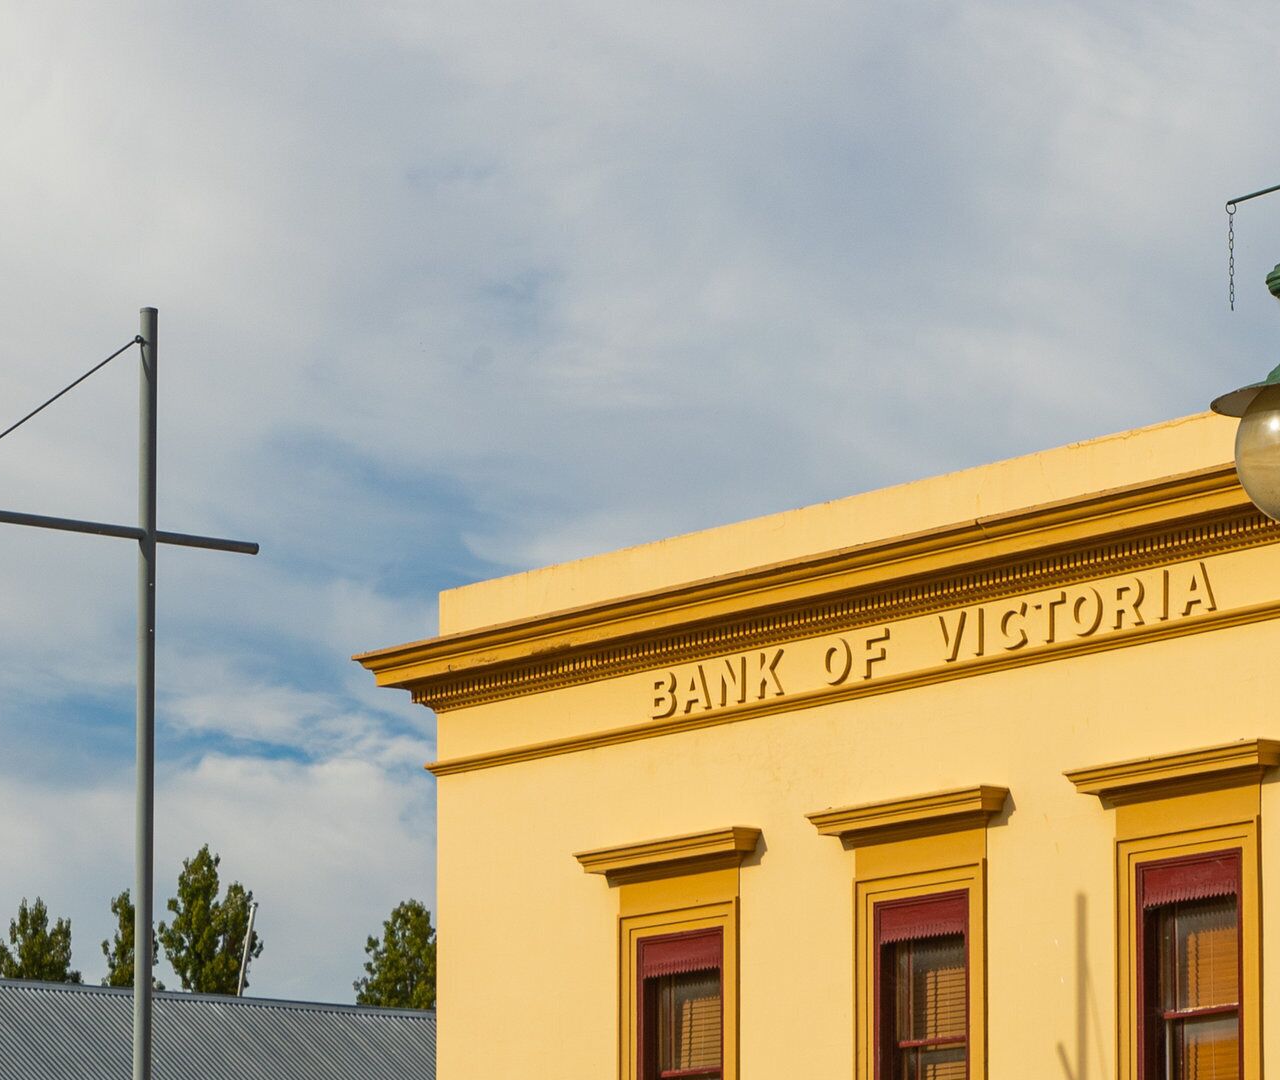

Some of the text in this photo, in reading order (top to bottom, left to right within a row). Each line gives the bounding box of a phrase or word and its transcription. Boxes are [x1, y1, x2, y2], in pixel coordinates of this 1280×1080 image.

[651, 562, 1218, 719] BANK OF VICTORIA
